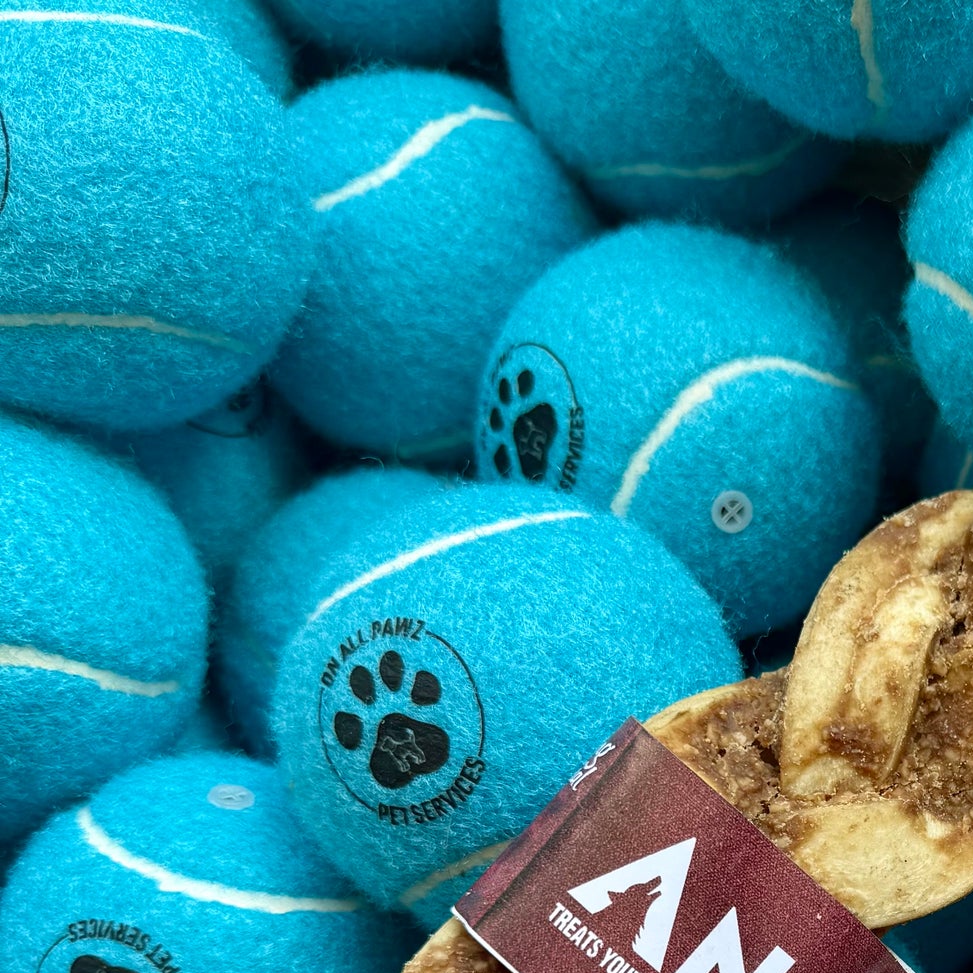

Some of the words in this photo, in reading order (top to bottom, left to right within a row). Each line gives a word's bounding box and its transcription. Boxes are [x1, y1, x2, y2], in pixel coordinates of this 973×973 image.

[321, 656, 341, 688] ON
[339, 629, 370, 662] ALL
[371, 617, 426, 641] PAWZ
[378, 802, 411, 826] PET
[410, 756, 486, 824] SERVICES
[68, 918, 152, 952] SERVICES
[548, 903, 604, 958] TREATS
